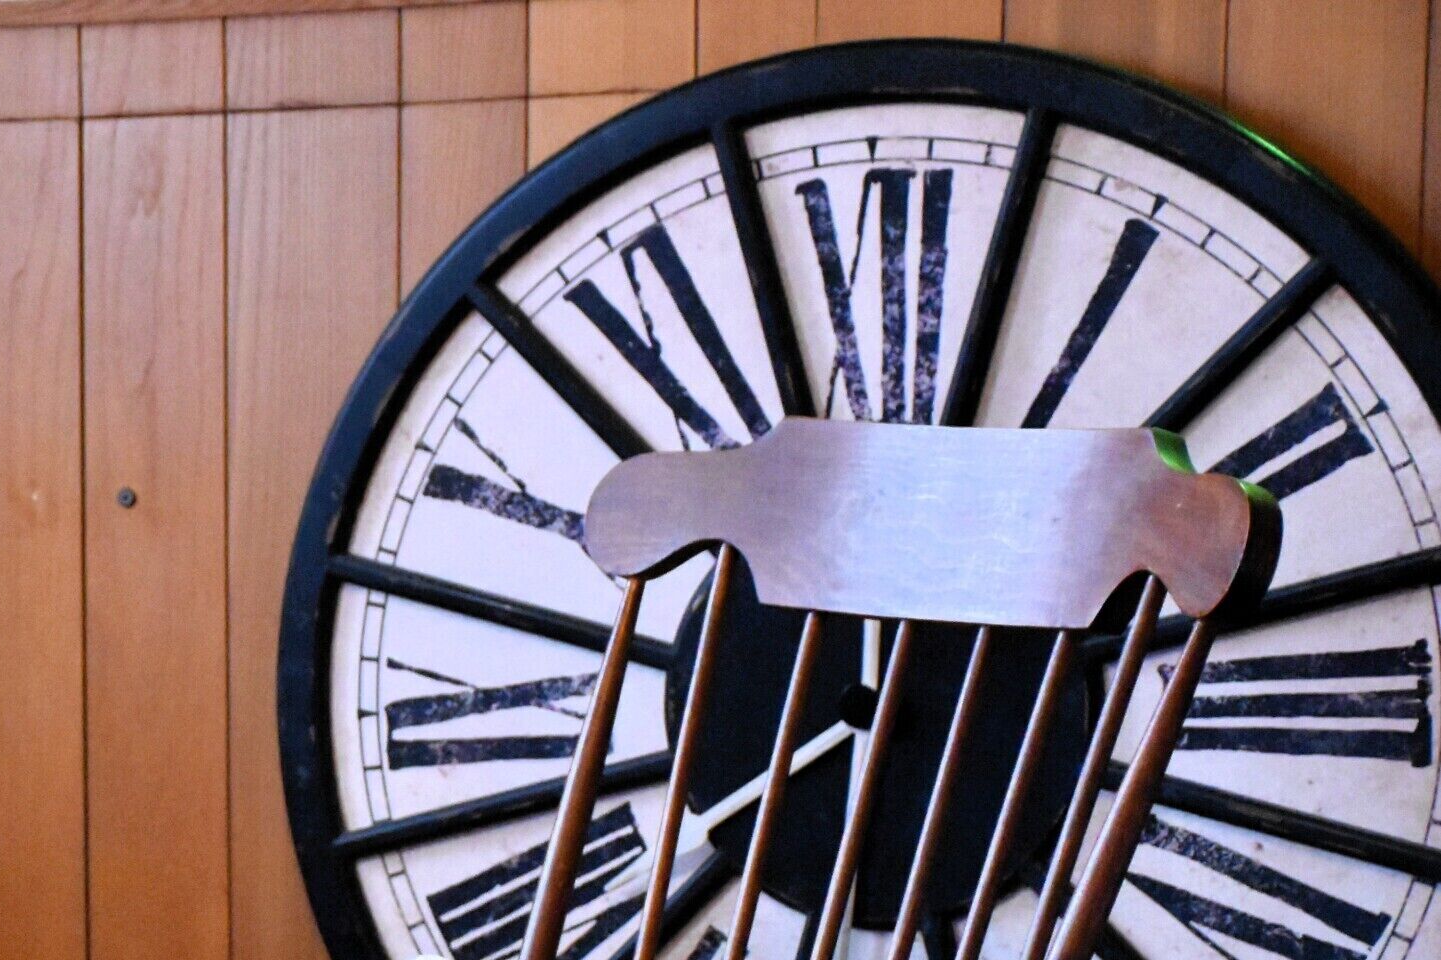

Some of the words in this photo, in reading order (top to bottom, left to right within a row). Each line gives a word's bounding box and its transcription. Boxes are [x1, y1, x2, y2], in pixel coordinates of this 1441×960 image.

[562, 222, 773, 452] XI
[795, 167, 955, 424] XII
[384, 656, 614, 770] IX
[1157, 638, 1433, 768] III
